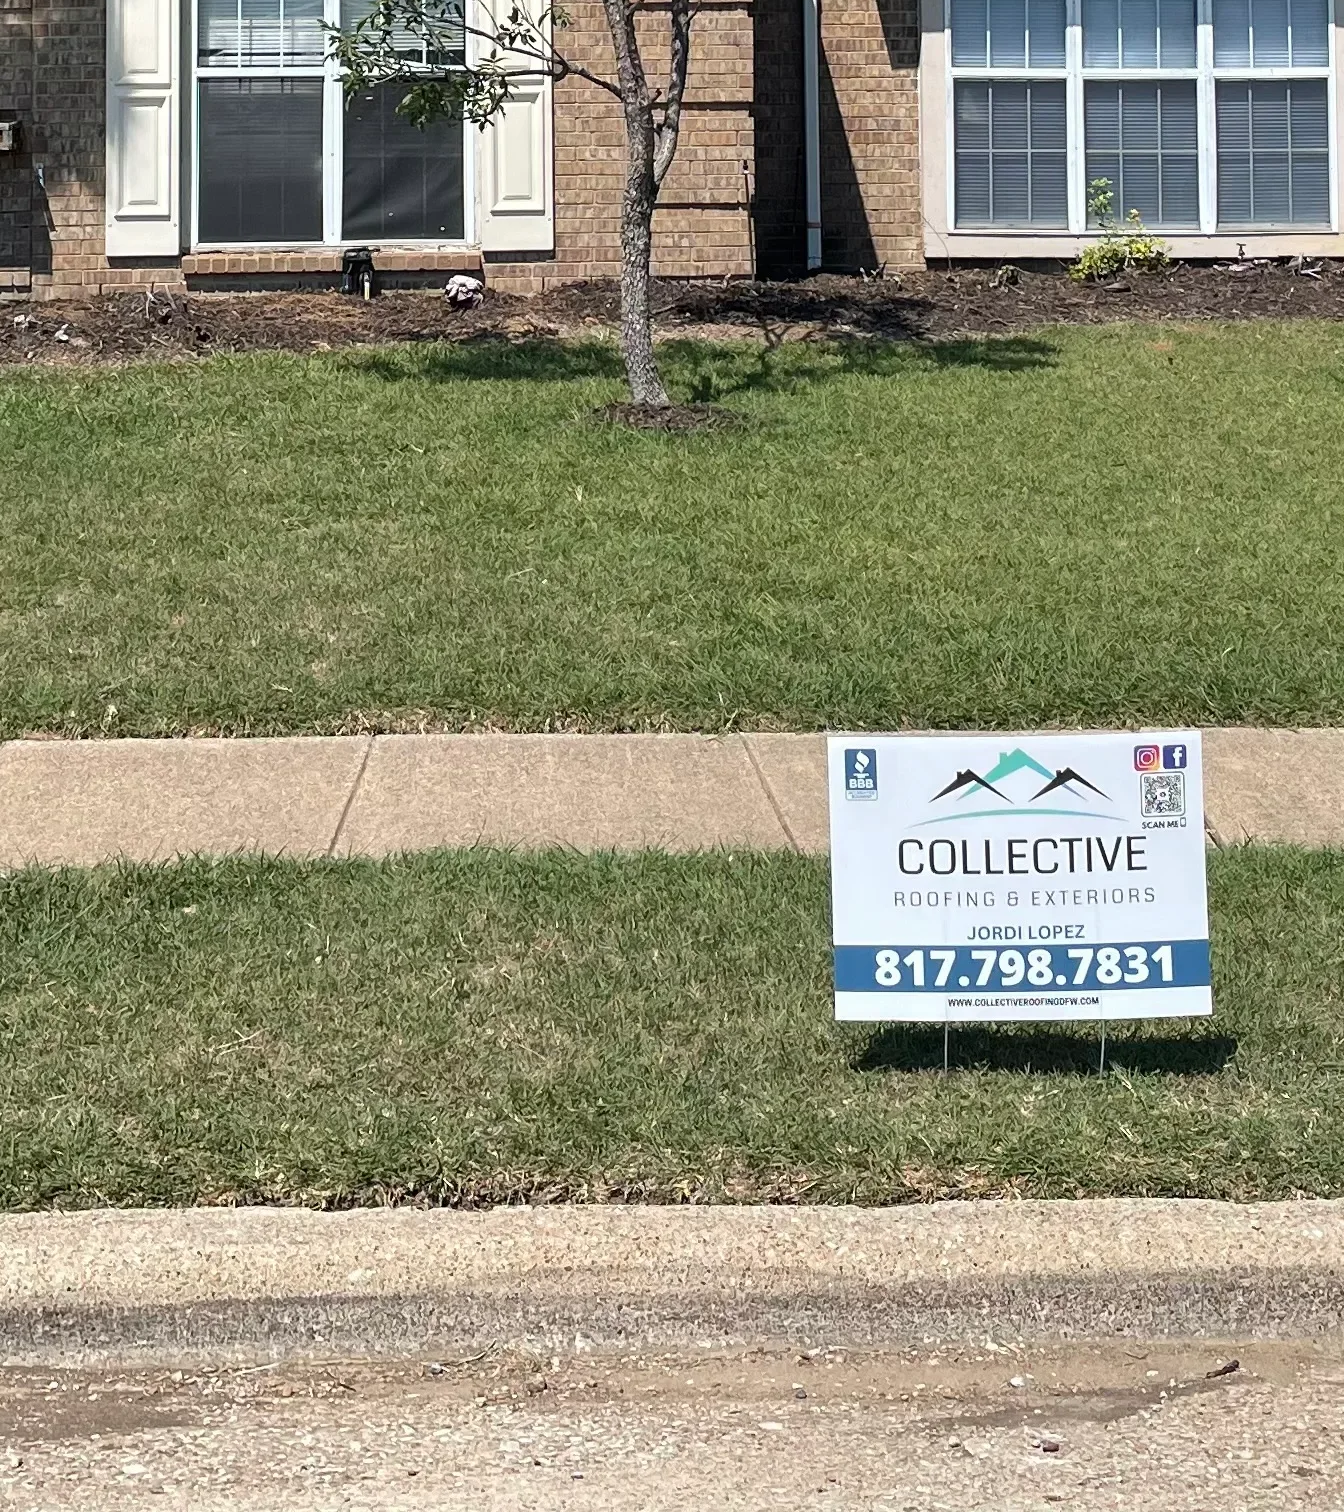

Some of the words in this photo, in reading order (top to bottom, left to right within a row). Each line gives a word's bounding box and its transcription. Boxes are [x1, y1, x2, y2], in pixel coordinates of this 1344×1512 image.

[849, 778, 874, 789] BBB
[1141, 821, 1166, 830] SCAN
[1166, 820, 1179, 828] ME
[898, 835, 1149, 876] COLLECTIVE
[894, 891, 996, 907] ROOFING
[1007, 891, 1019, 906] &
[1031, 887, 1157, 906] EXTERIORS
[967, 925, 1023, 941] JORDI
[1028, 924, 1086, 940] LOPEZ
[875, 944, 1175, 988] 817.798.7831
[947, 996, 1100, 1007] WWW.COLLECTIVEROOFINGDFW.COM
